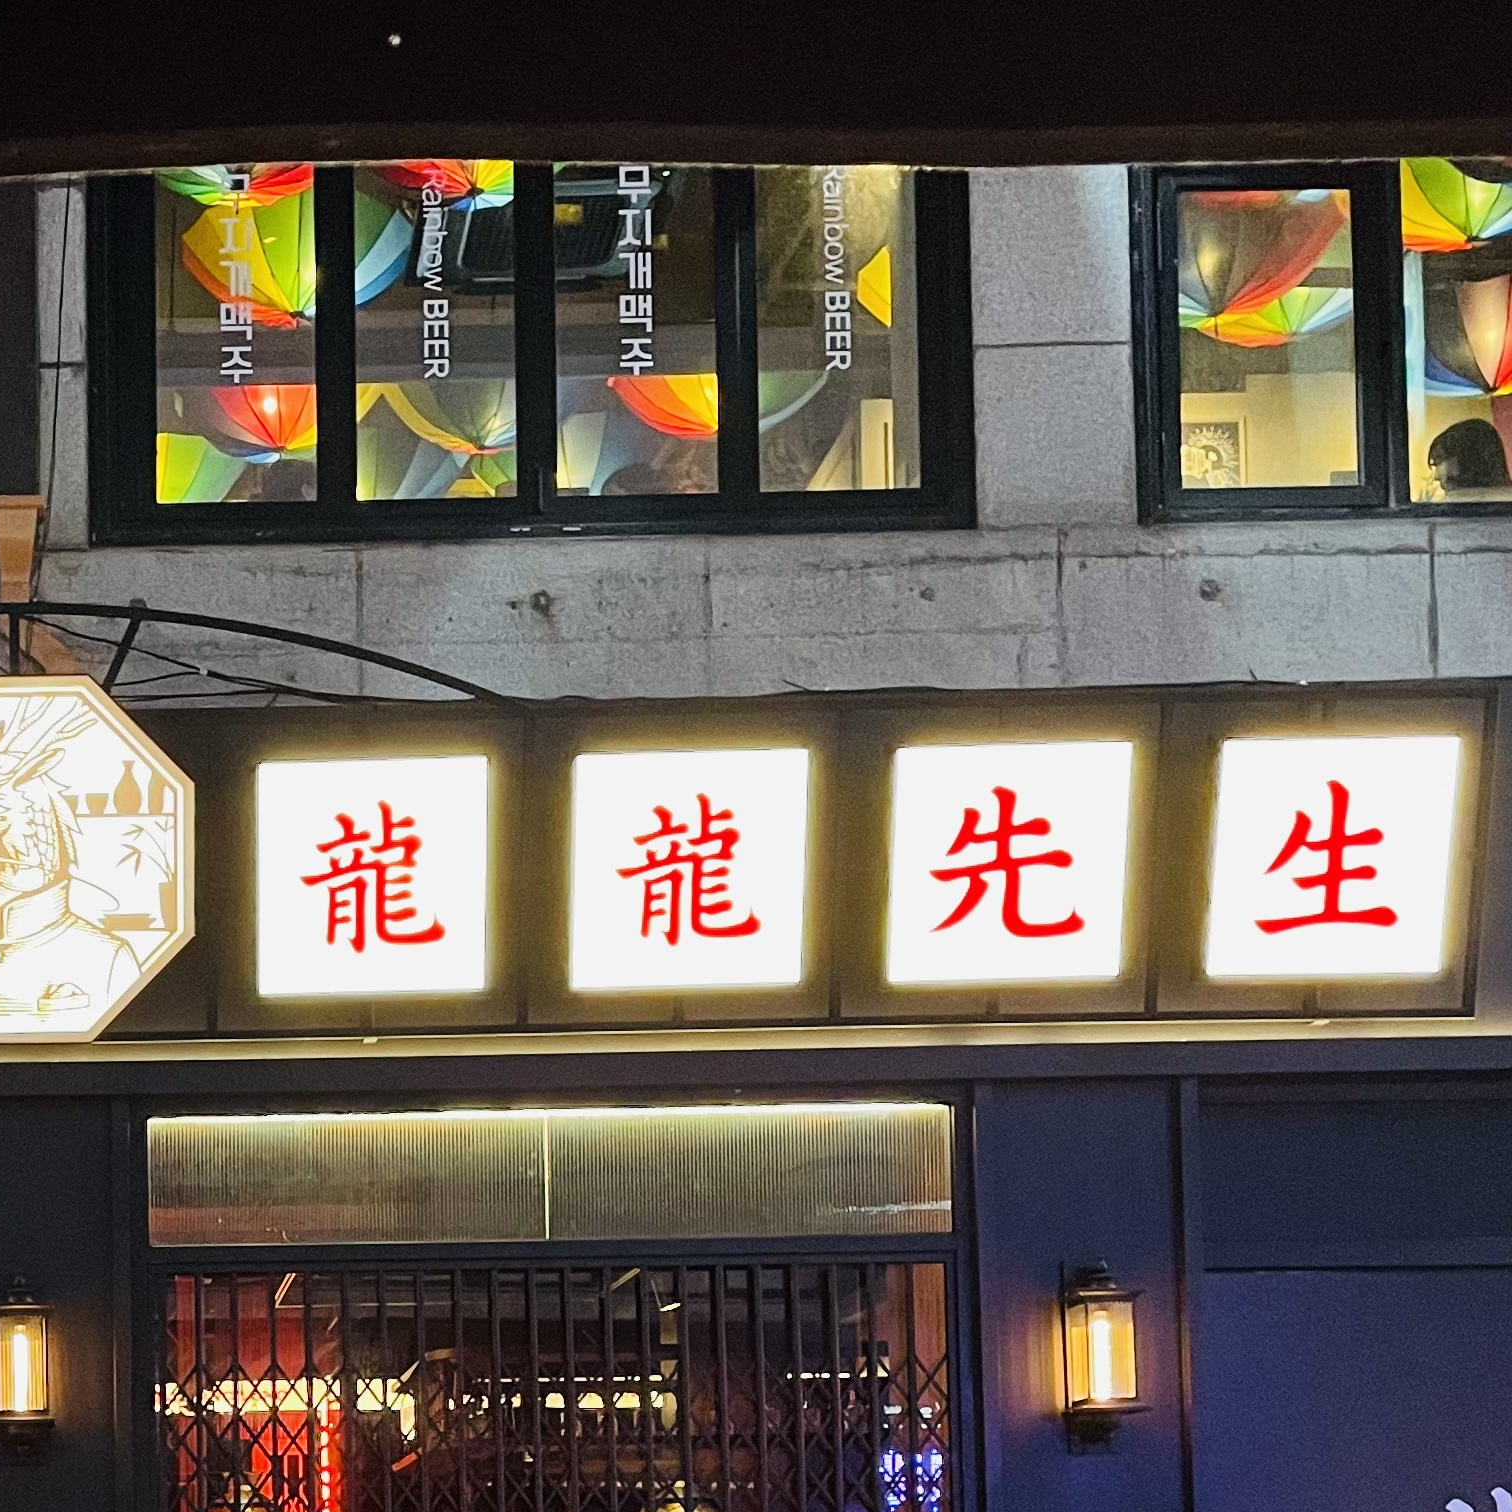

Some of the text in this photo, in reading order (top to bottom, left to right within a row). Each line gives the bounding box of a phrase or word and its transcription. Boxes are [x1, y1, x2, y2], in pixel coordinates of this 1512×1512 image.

[219, 173, 254, 384] 무지개맥주
[423, 299, 450, 379] BEER
[617, 165, 654, 376] 무지개맥주
[822, 165, 852, 371] Rainbow BEER
[300, 779, 1399, 954] 龍龍先生
